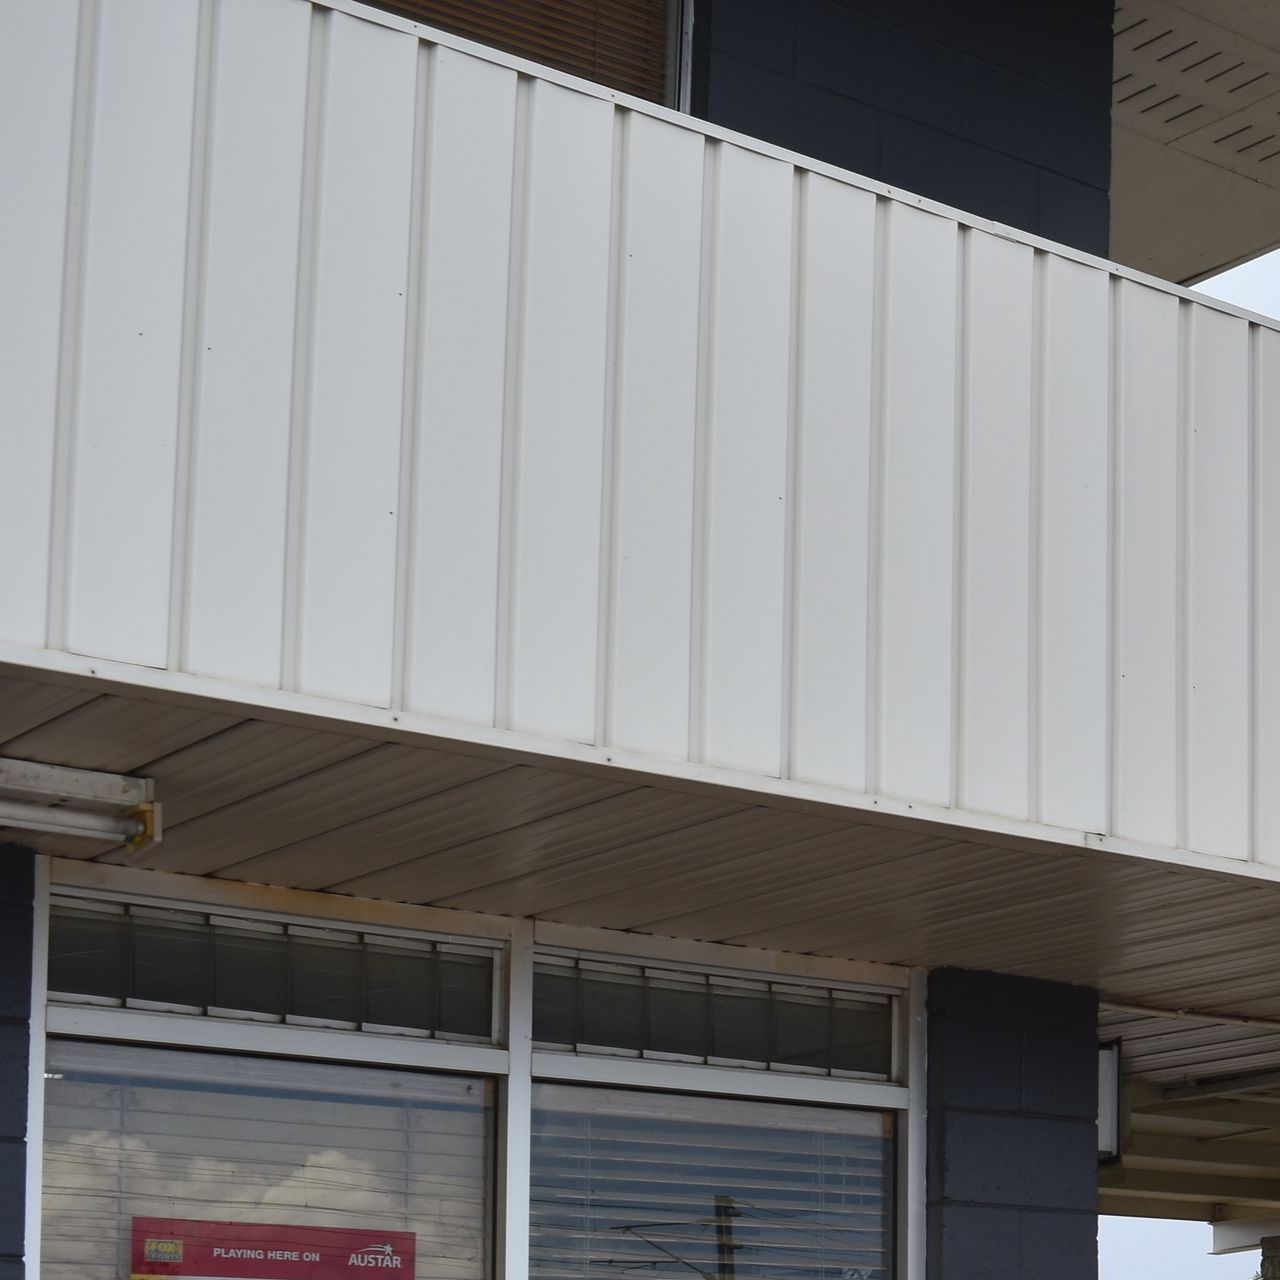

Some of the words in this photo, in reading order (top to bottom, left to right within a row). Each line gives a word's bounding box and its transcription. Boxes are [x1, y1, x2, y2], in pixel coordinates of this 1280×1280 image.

[213, 1248, 264, 1259] PLAYING
[267, 1250, 299, 1260] HERE
[303, 1252, 320, 1262] ON
[348, 1253, 401, 1268] AUSTAR
